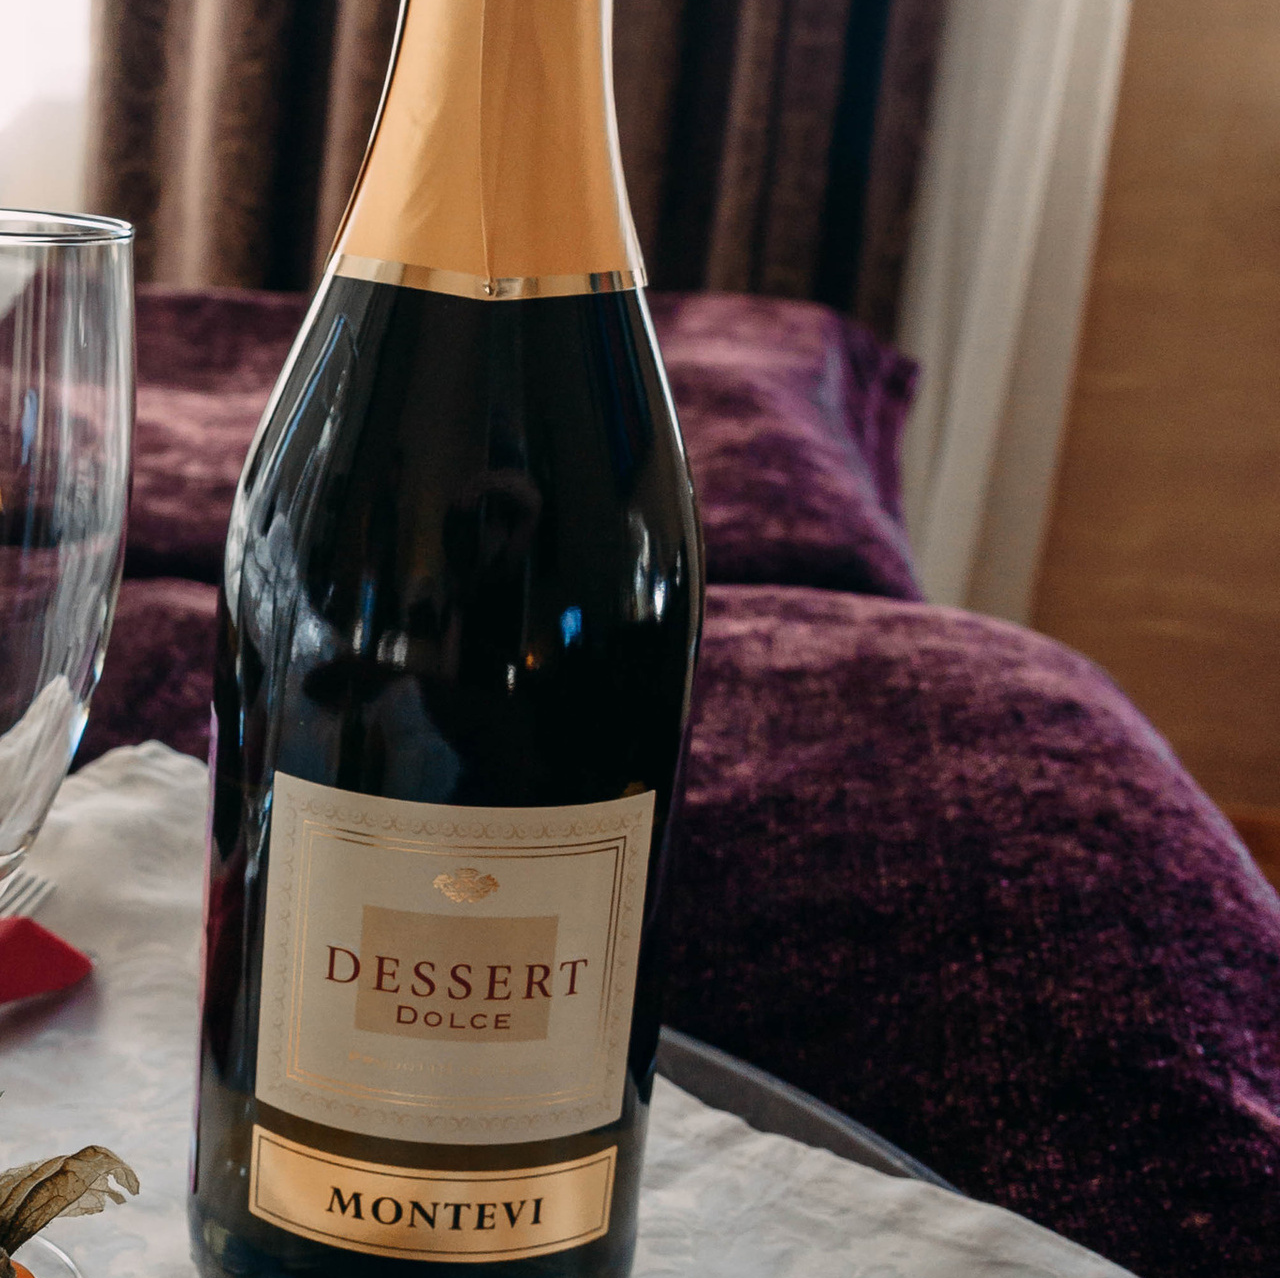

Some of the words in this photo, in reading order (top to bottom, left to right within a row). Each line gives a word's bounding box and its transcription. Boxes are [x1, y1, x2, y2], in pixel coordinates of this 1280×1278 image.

[325, 945, 588, 1001] DESSERT
[396, 1005, 512, 1029] DOLCE
[326, 1186, 544, 1230] MONTEVI
